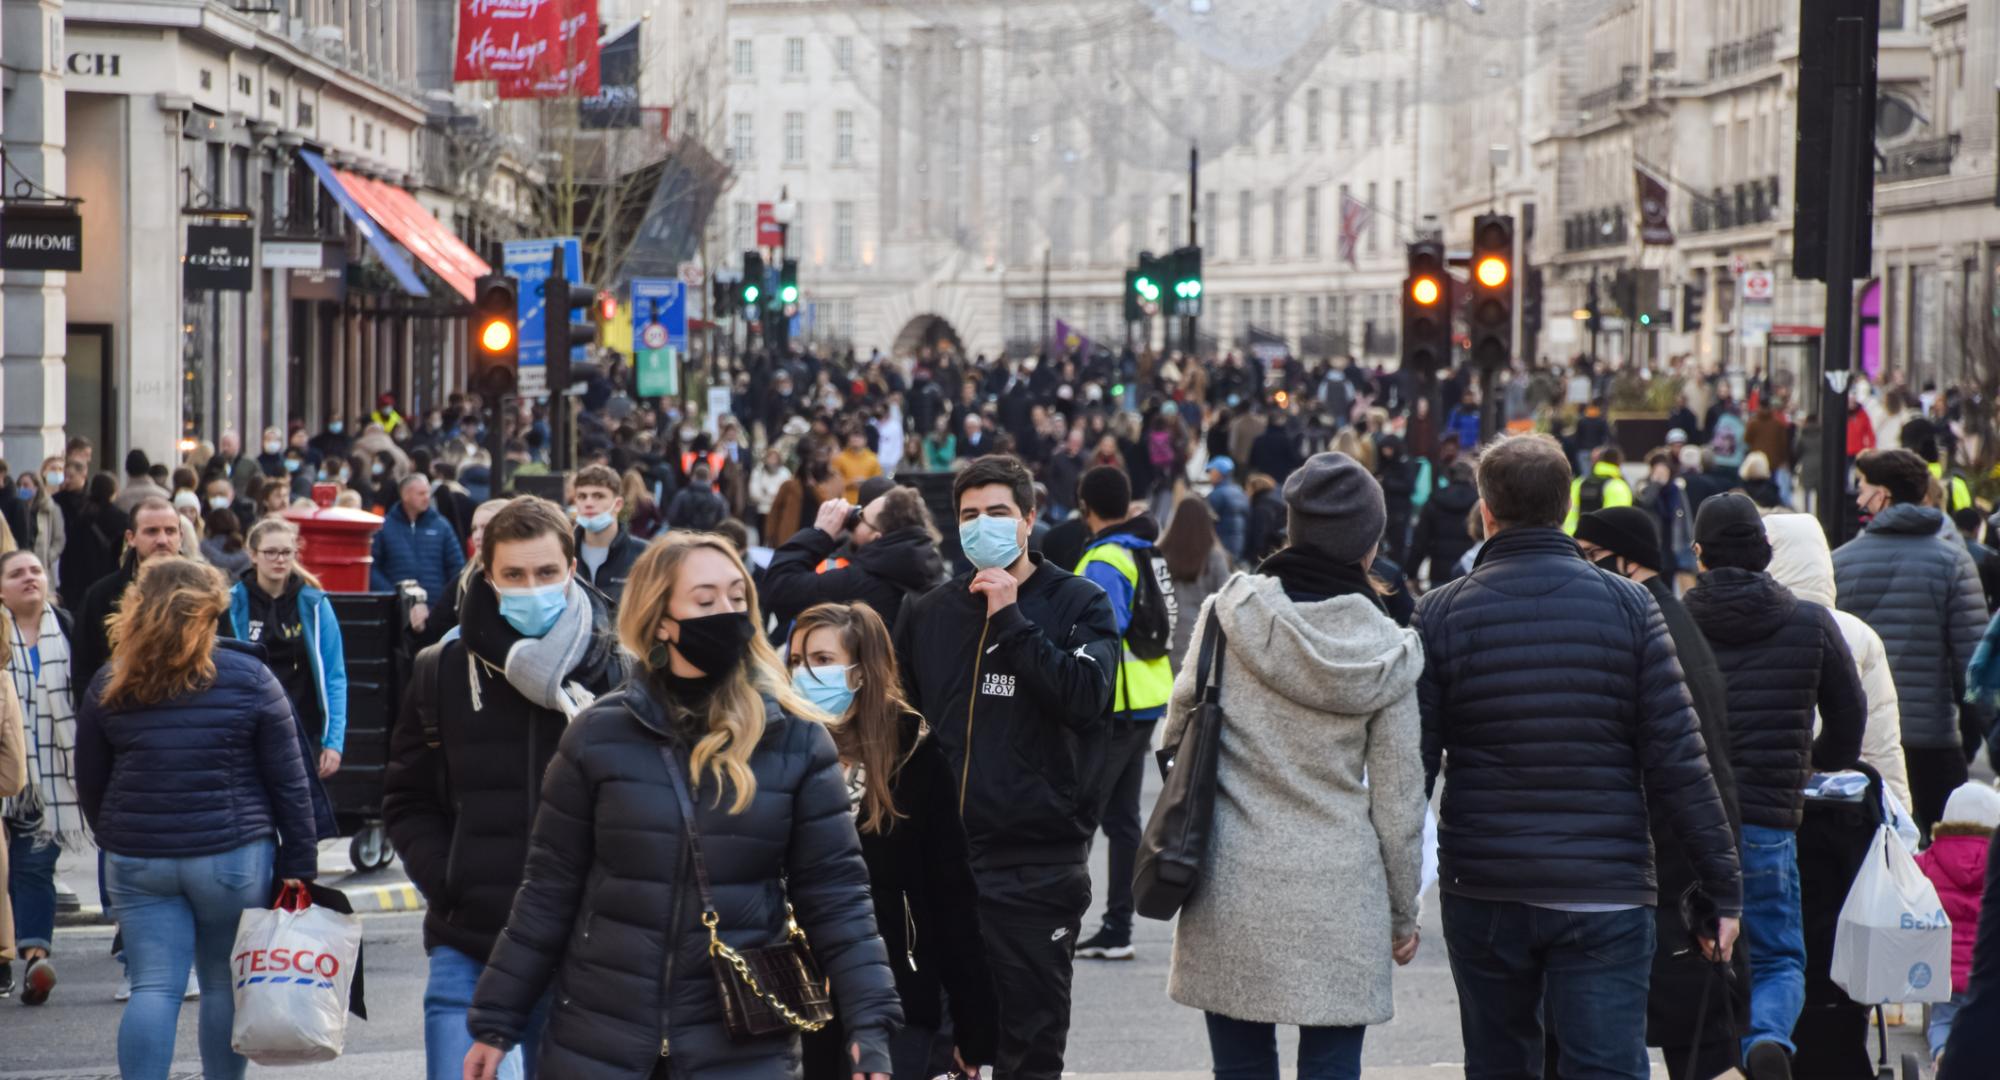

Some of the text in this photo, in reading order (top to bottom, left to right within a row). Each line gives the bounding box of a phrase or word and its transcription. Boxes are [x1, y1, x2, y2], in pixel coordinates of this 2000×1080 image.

[465, 27, 547, 70] Hamleys
[67, 52, 120, 76] CH
[28, 233, 75, 251] HOME
[985, 673, 1015, 685] 1985
[234, 948, 339, 977] TESCO
